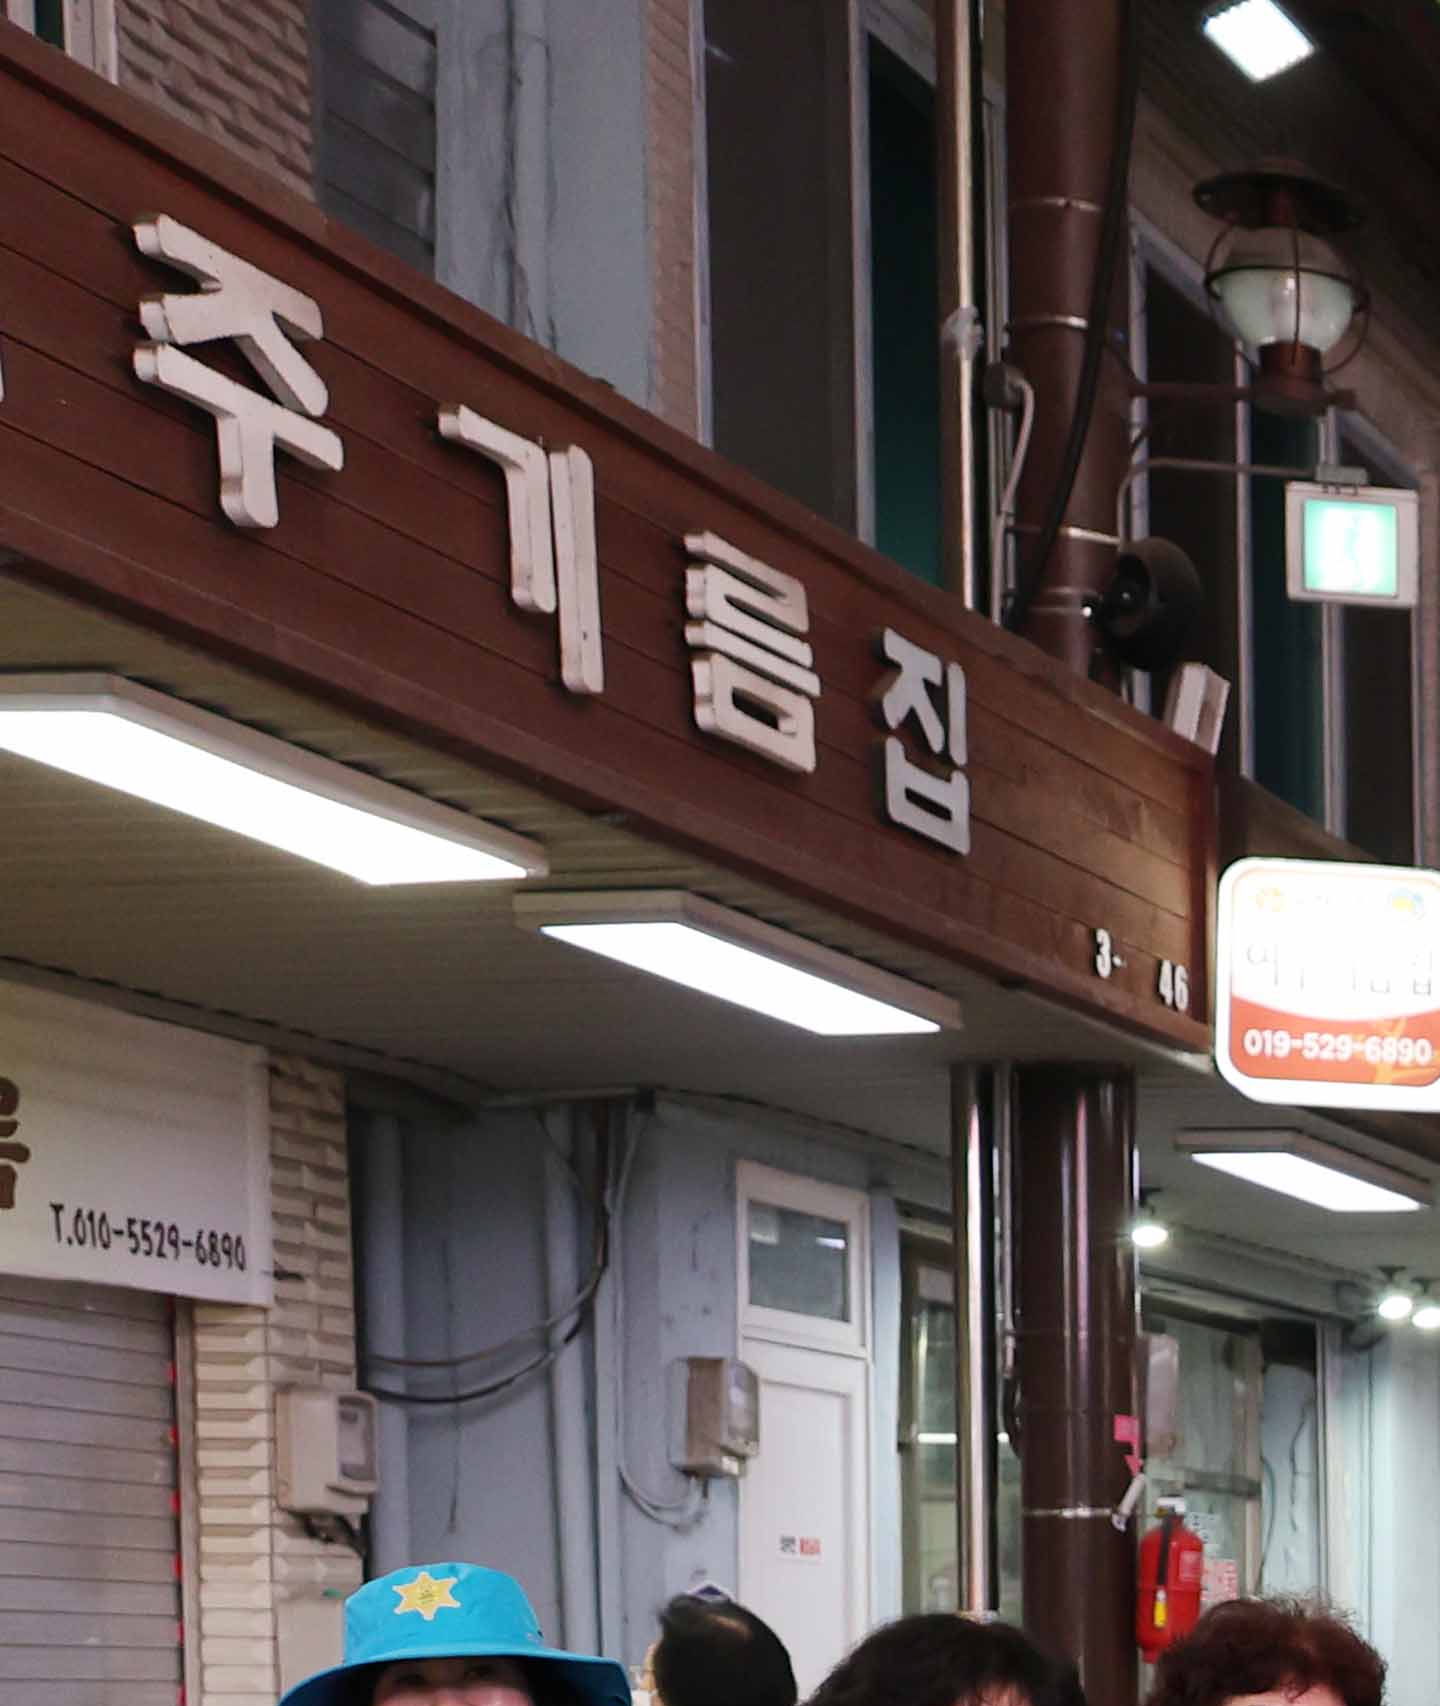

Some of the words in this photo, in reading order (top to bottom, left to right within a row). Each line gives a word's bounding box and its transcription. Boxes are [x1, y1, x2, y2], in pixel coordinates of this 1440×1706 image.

[0, 211, 972, 855] 주기름집
[1156, 960, 1189, 1011] 46
[1244, 1028, 1432, 1064] 019-529-6890
[50, 1203, 248, 1272] T.010-5529-6890
